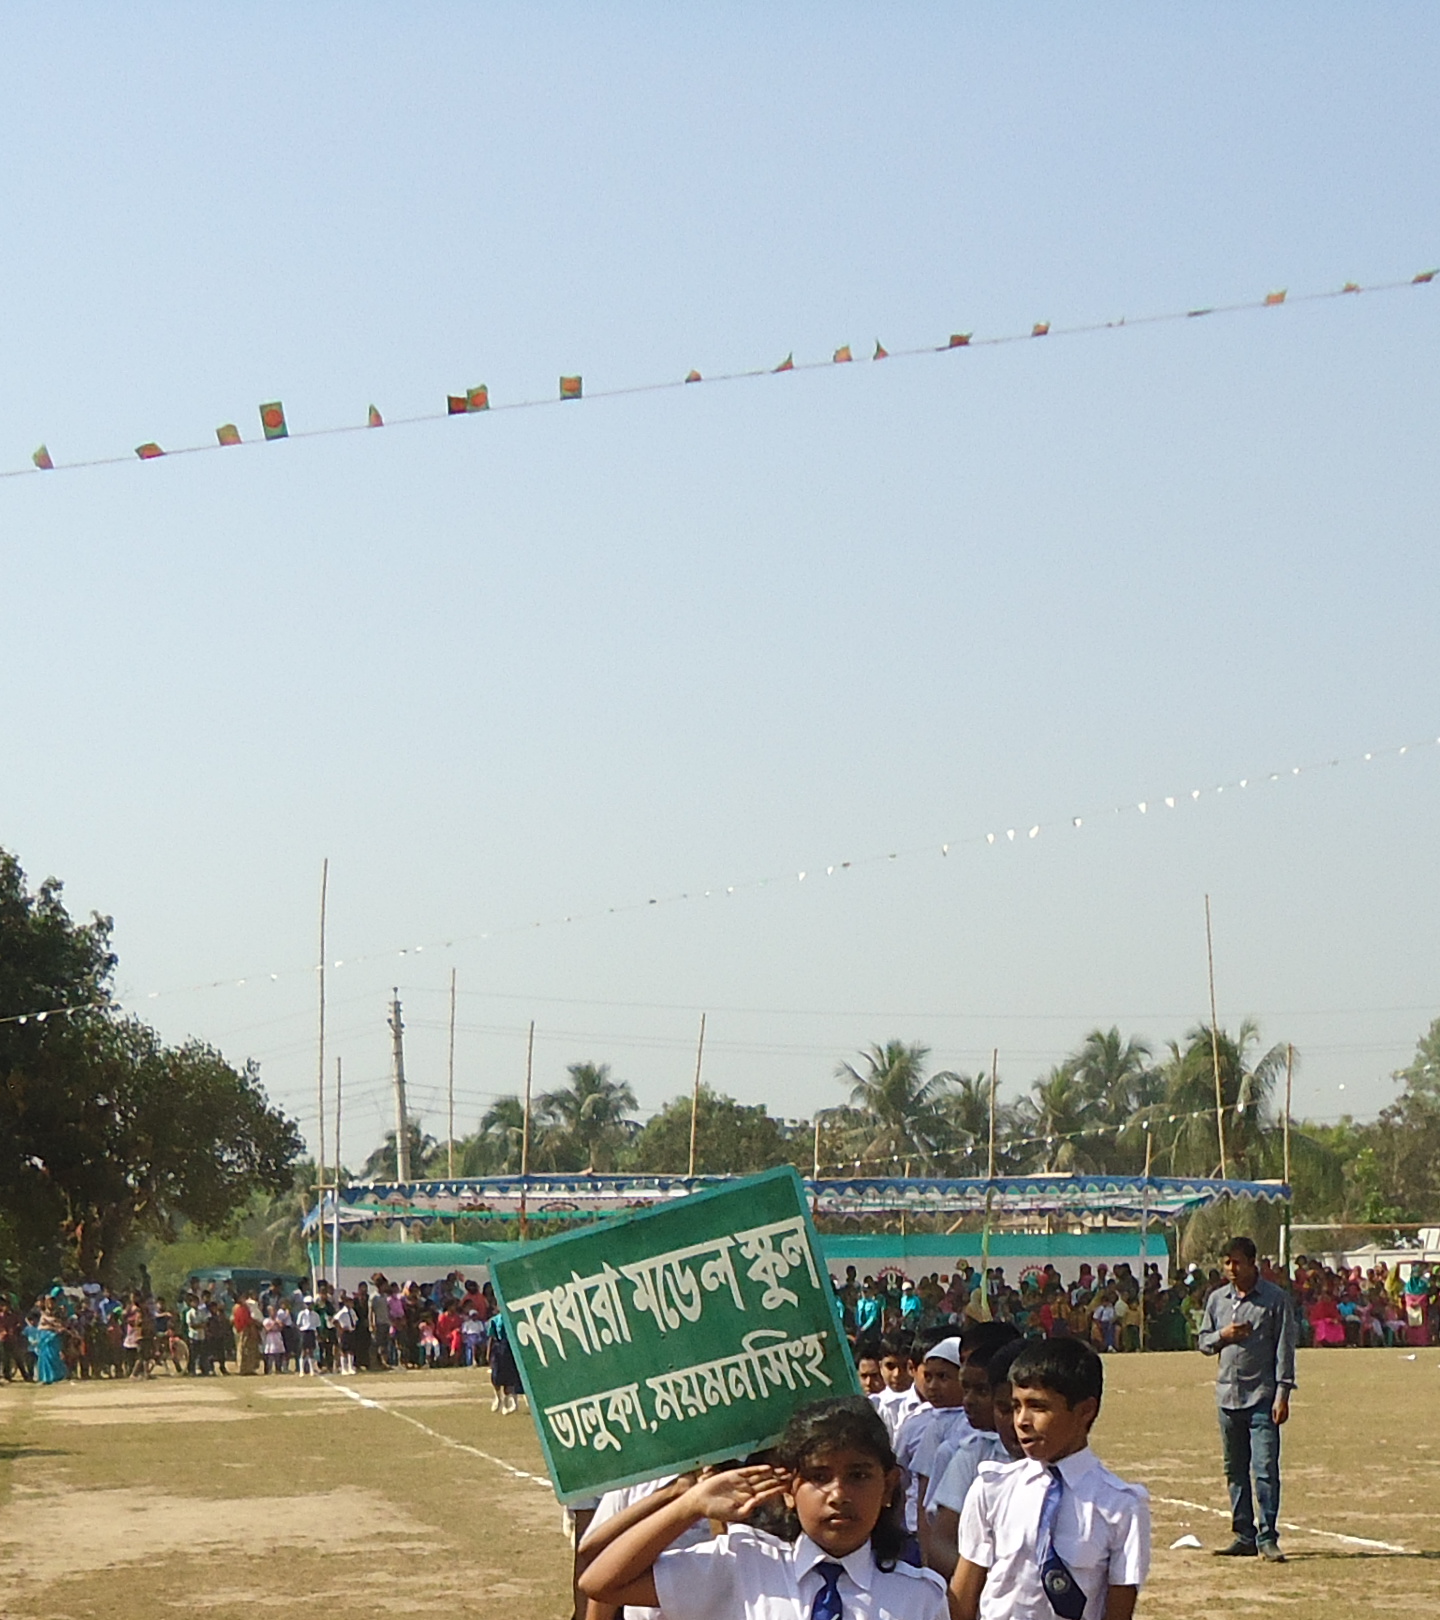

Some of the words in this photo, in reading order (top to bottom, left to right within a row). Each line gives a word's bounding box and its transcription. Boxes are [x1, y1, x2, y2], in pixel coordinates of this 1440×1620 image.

[506, 1262, 632, 1367] নবধারা
[621, 1236, 745, 1334] মডেল
[734, 1216, 821, 1310] স্কুল
